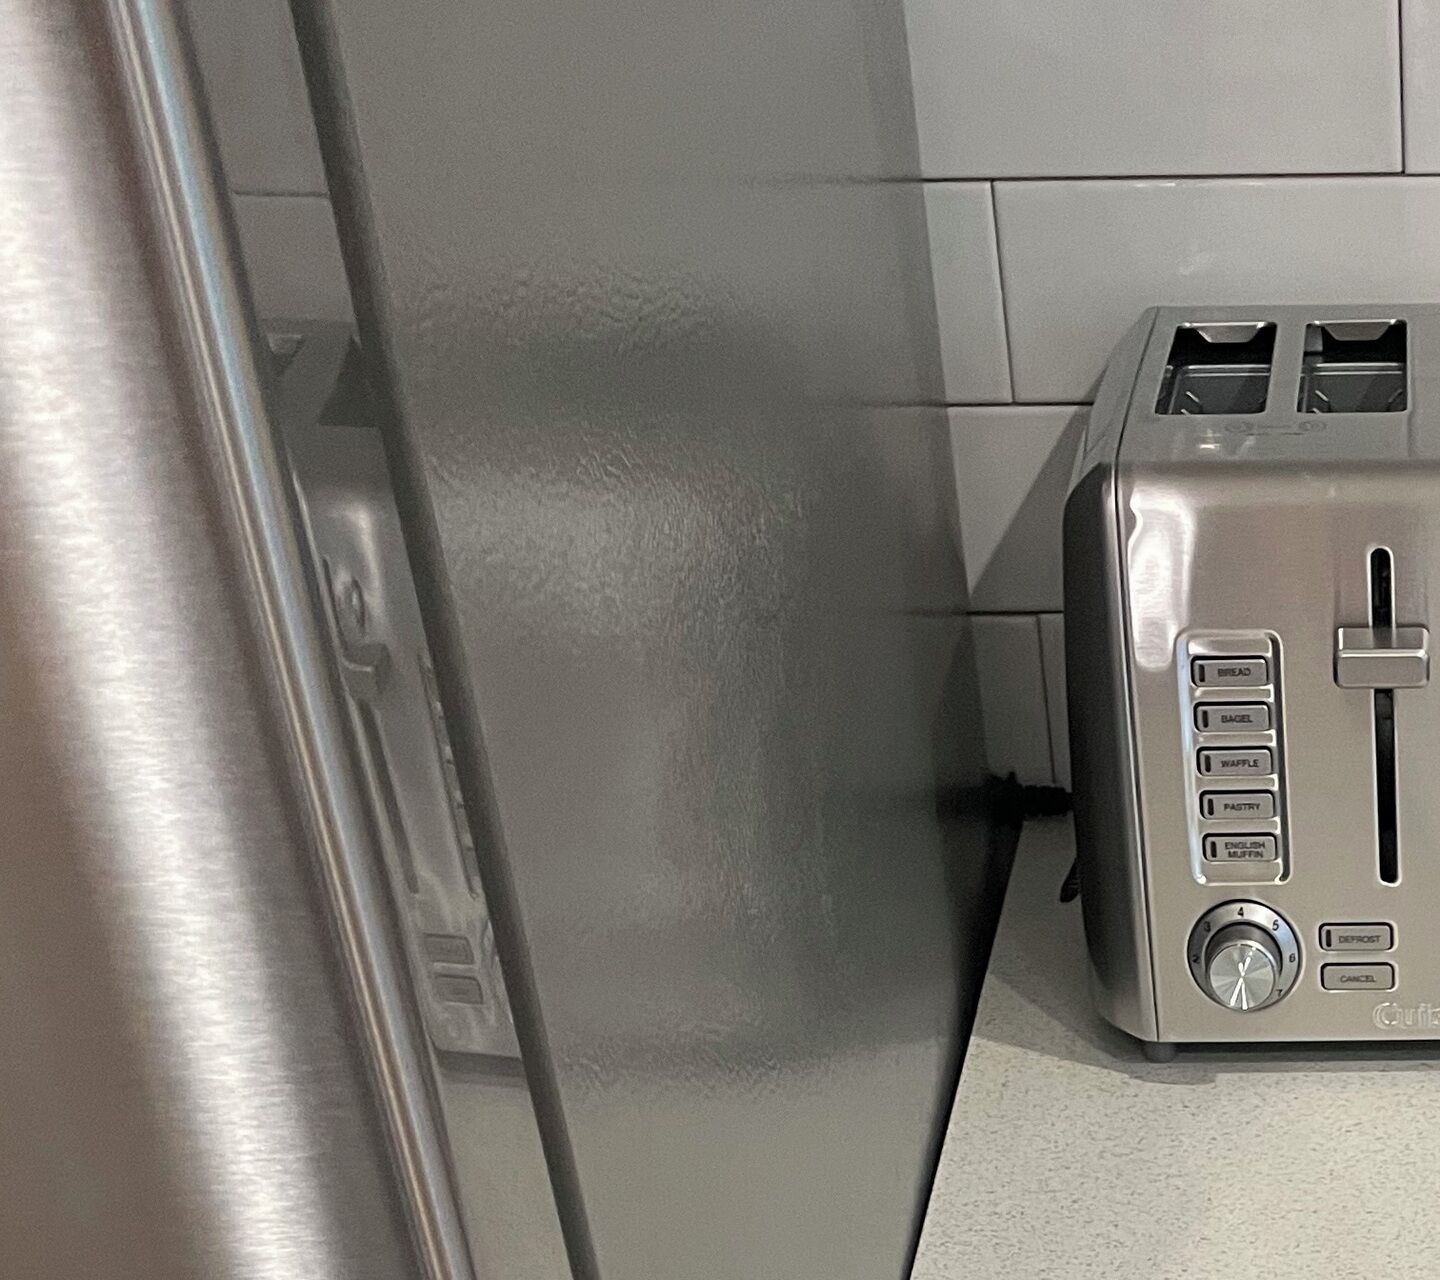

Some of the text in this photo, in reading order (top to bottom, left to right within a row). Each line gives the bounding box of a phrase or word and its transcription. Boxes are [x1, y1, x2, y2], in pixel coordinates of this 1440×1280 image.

[1217, 668, 1251, 677] BREAD
[1221, 714, 1253, 724] BAGEL
[1220, 759, 1260, 768] WAFFLE
[1223, 802, 1261, 811] PASTRY
[1224, 841, 1265, 850] ENGLISH
[1227, 850, 1264, 859] MUFFIN
[1338, 934, 1382, 944] DEFROST
[1340, 974, 1377, 983] CANCEL
